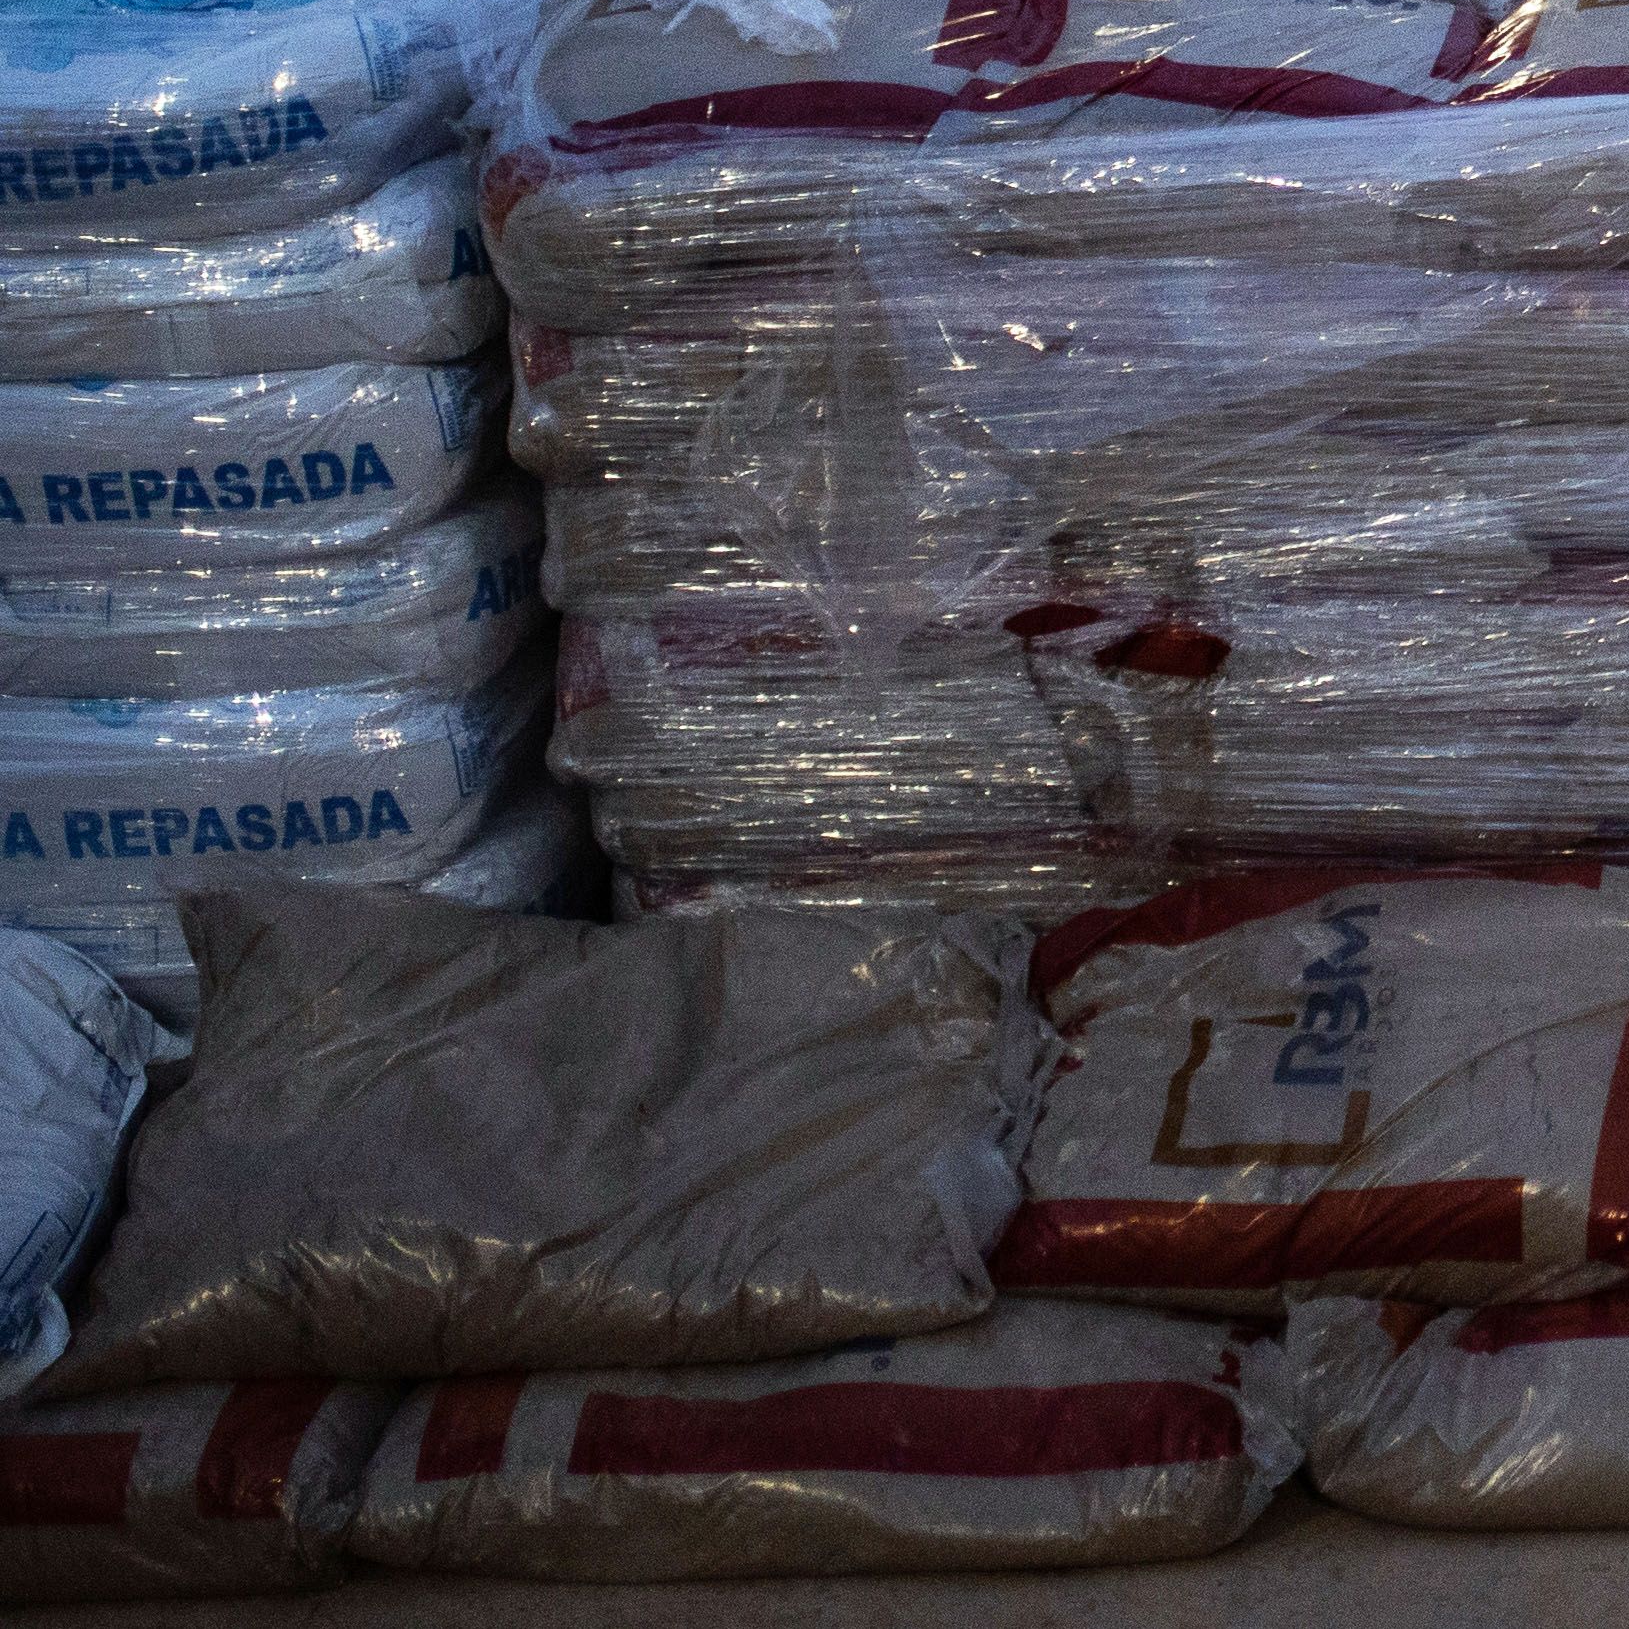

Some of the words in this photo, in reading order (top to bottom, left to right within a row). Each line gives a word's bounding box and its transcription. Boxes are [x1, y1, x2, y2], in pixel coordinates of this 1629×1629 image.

[0, 93, 328, 204] REPASADA
[43, 442, 395, 525] REPASADA
[65, 788, 414, 861] REPASADA
[1273, 903, 1382, 1086] RBM
